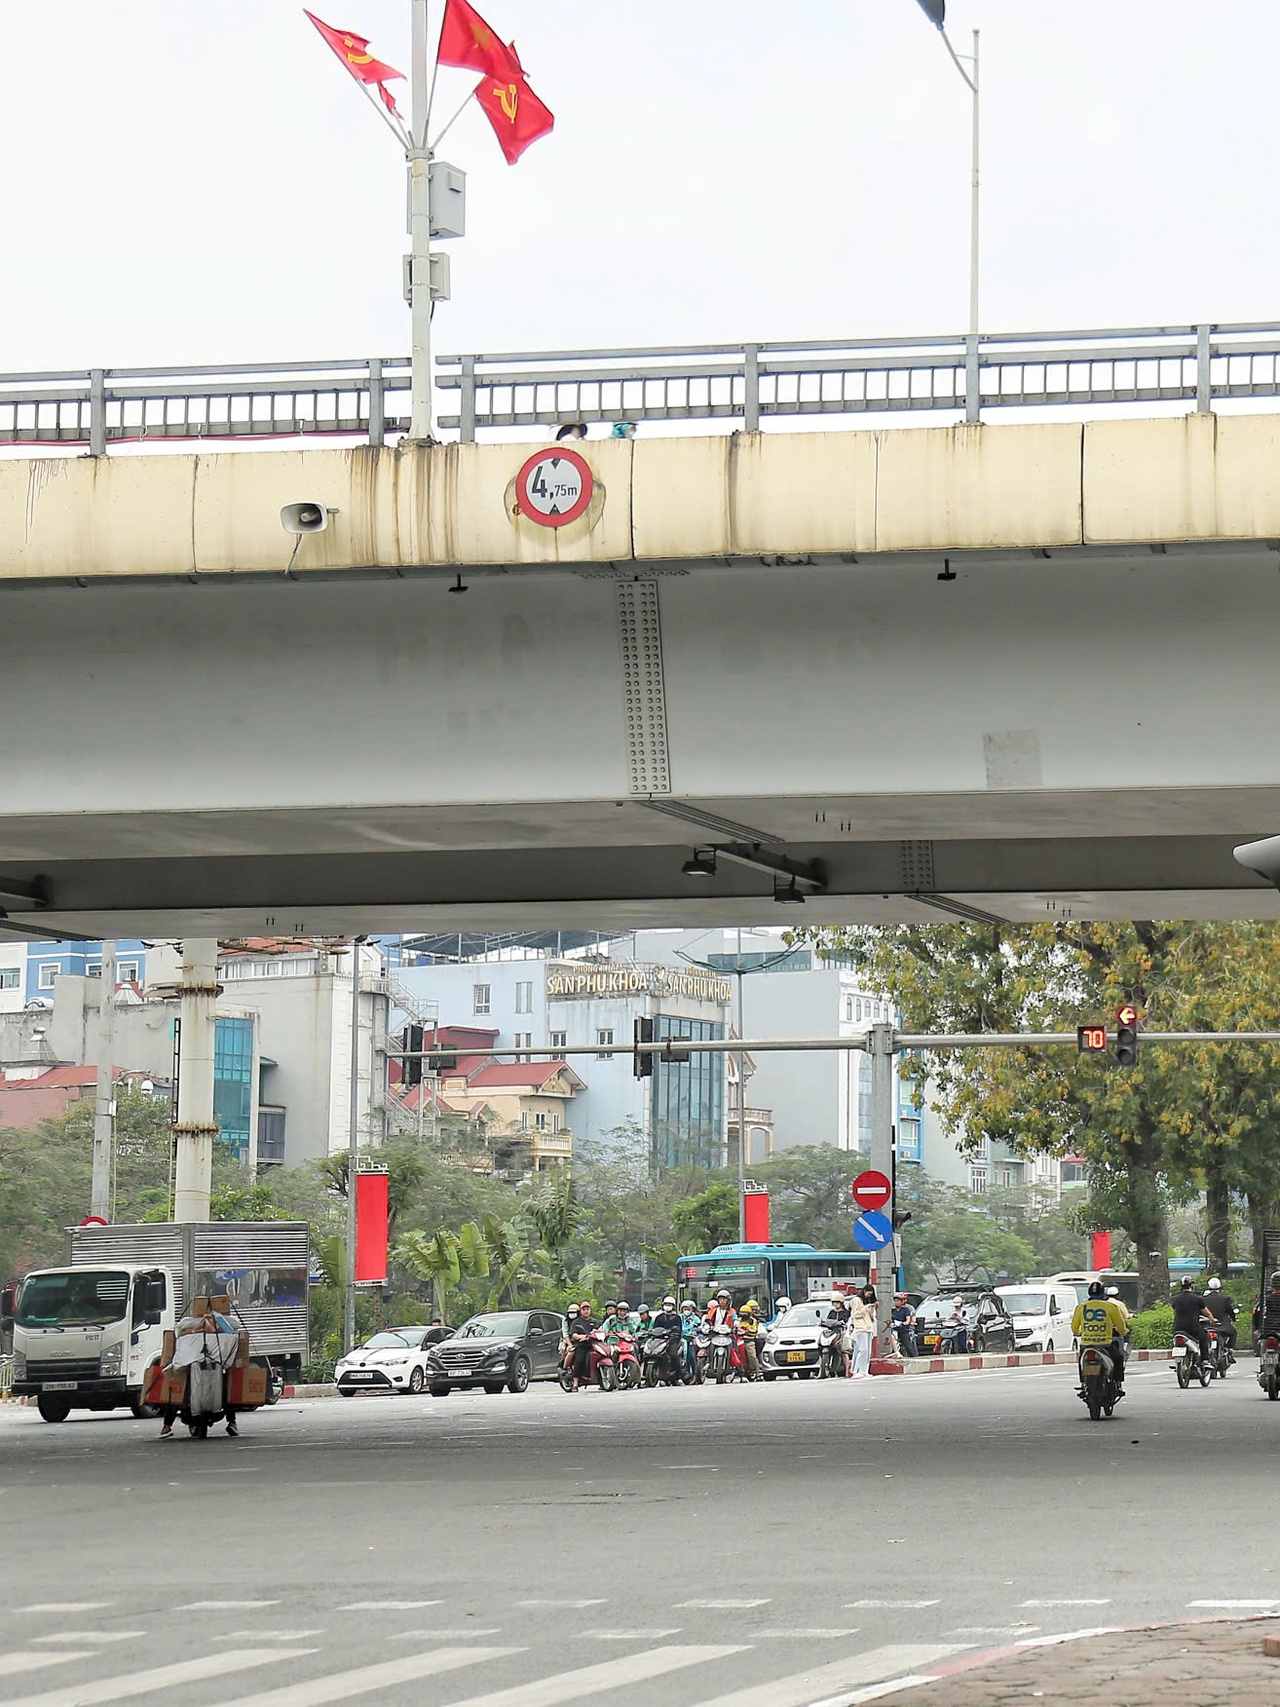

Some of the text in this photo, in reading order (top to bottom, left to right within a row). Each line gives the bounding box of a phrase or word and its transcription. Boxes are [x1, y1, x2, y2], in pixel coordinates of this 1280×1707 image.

[531, 465, 578, 500] 4,75m
[609, 972, 648, 991] KHOA
[1082, 1029, 1104, 1049] 70
[1083, 1304, 1107, 1322] be
[1083, 1323, 1107, 1332] Food
